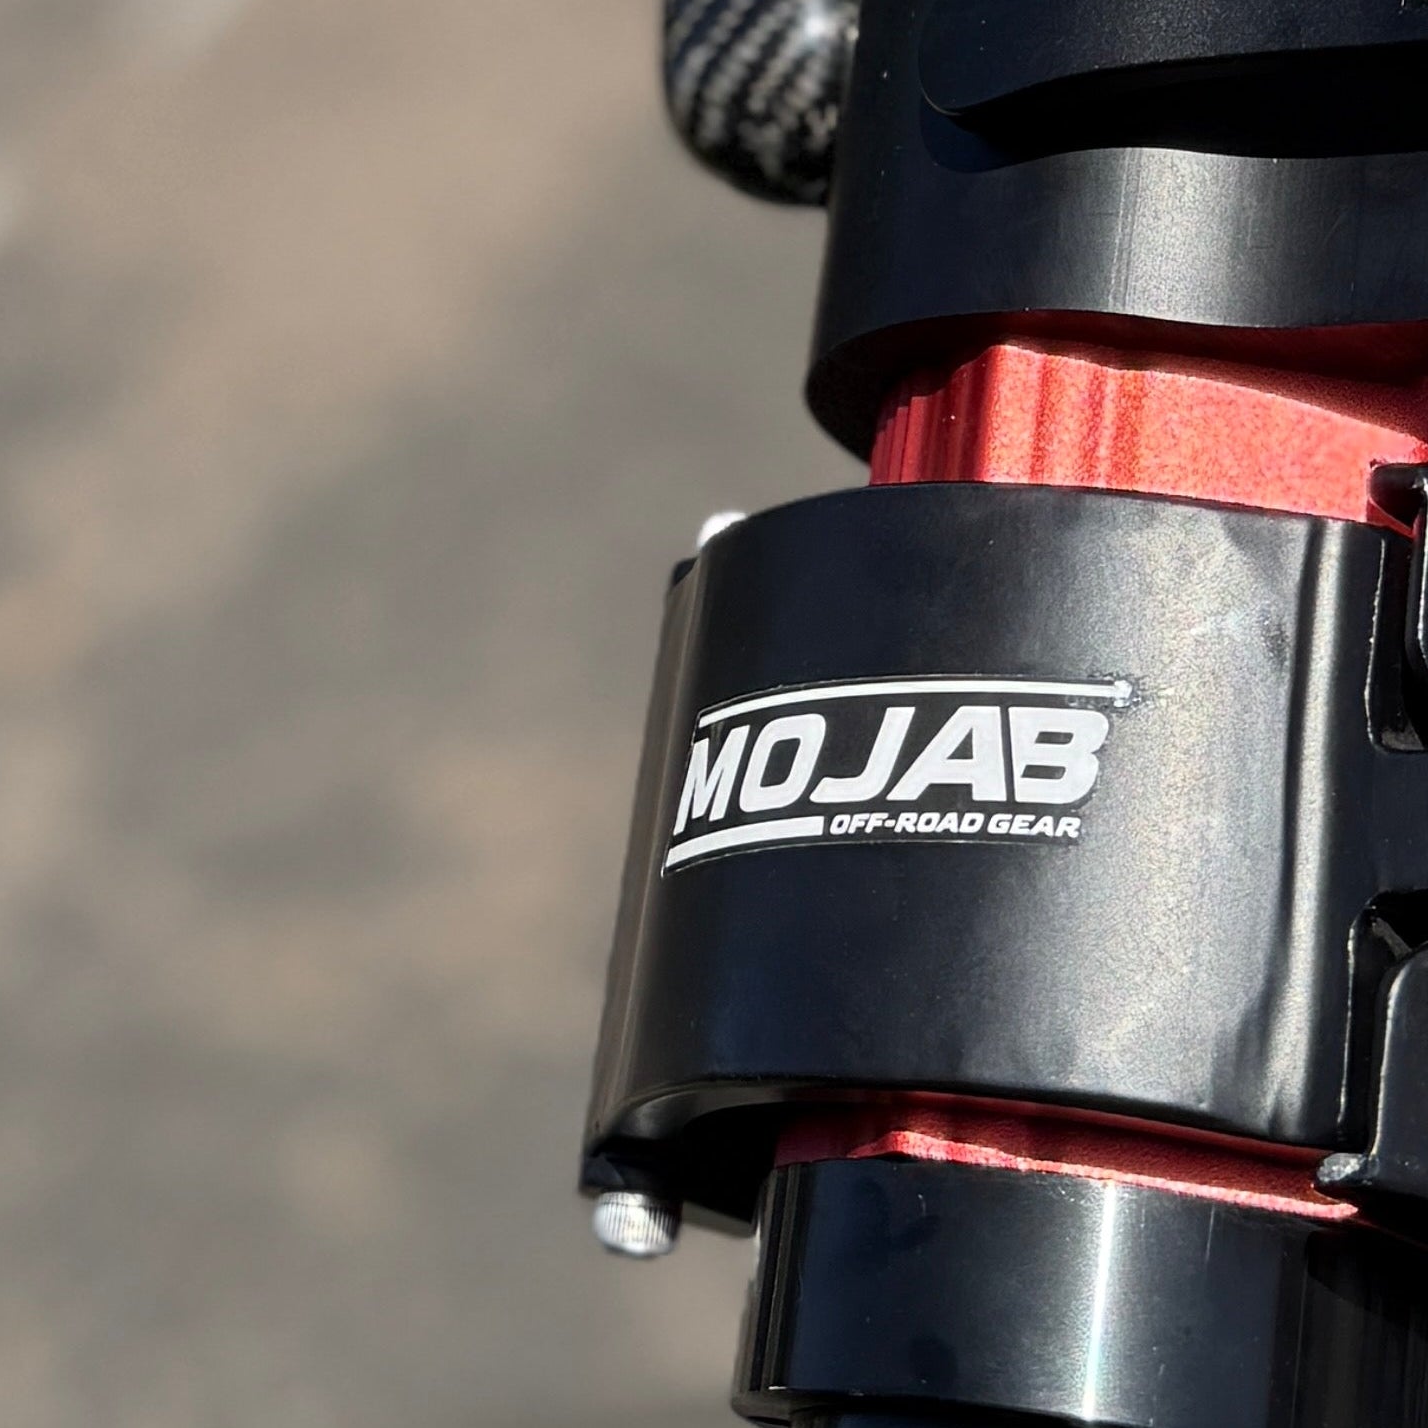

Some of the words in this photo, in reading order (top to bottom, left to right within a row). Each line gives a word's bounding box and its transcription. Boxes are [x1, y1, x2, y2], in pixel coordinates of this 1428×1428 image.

[673, 705, 1110, 837] MOJAB
[829, 812, 985, 835] OFF-ROAD
[987, 813, 1082, 839] GEAR
